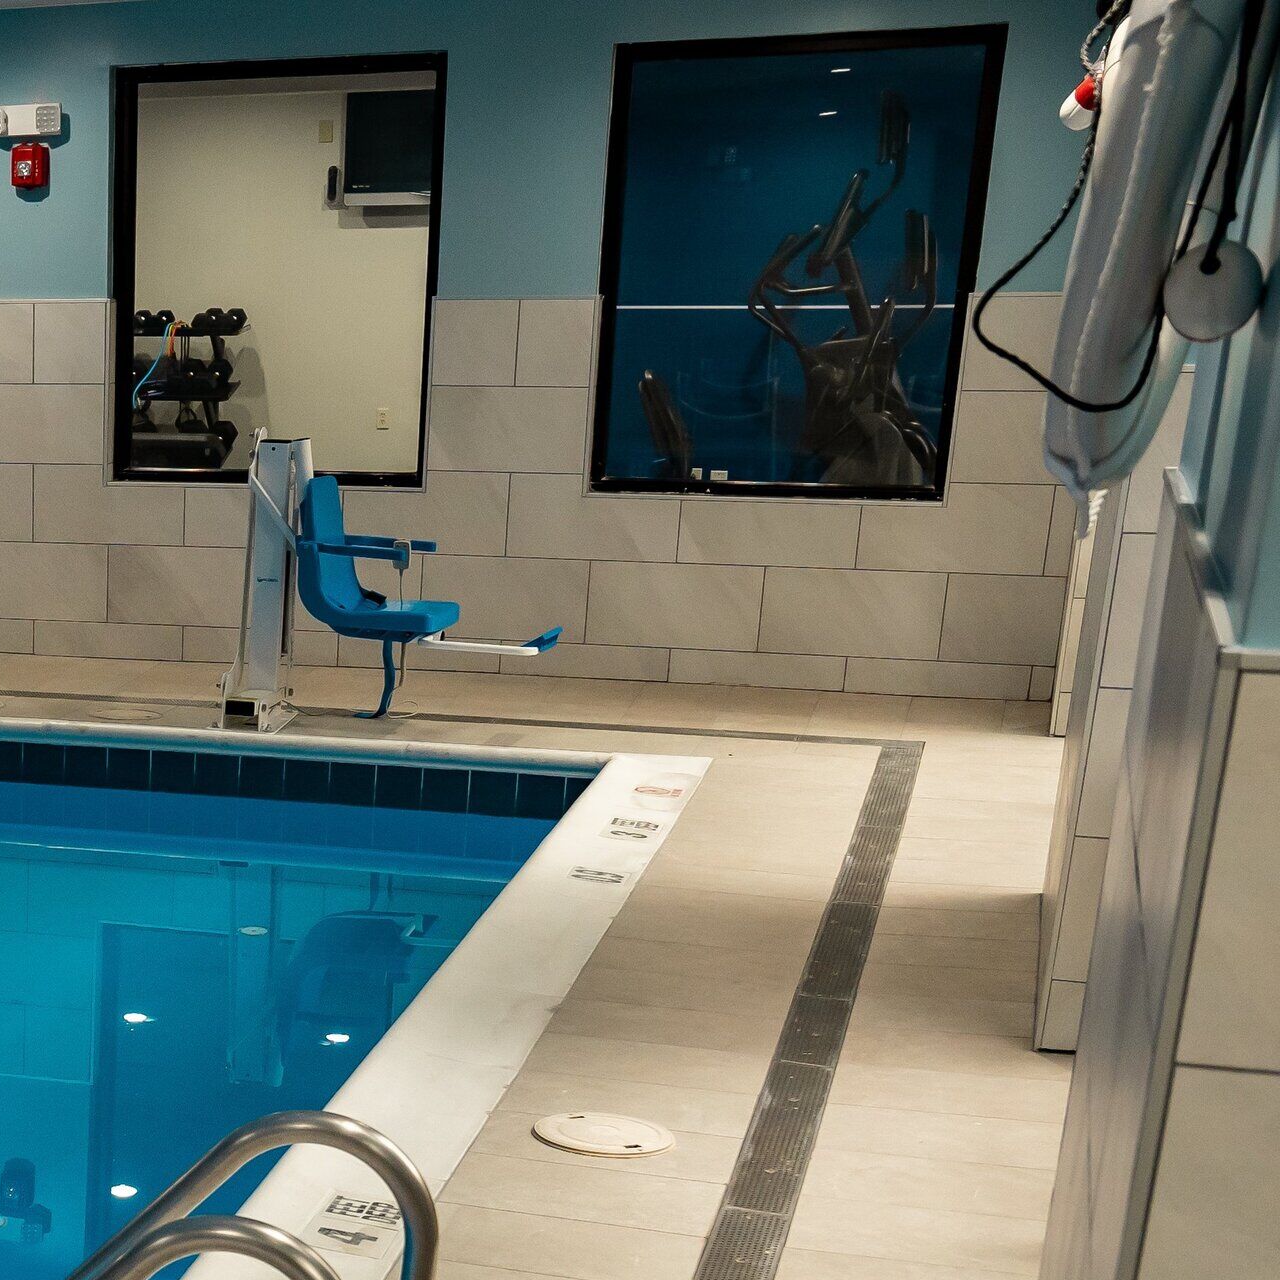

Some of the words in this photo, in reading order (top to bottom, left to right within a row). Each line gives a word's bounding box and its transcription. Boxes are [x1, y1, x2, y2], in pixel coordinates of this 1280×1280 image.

[325, 1195, 370, 1218] FEET
[361, 1202, 401, 1225] DEEP
[318, 1227, 378, 1245] 4
